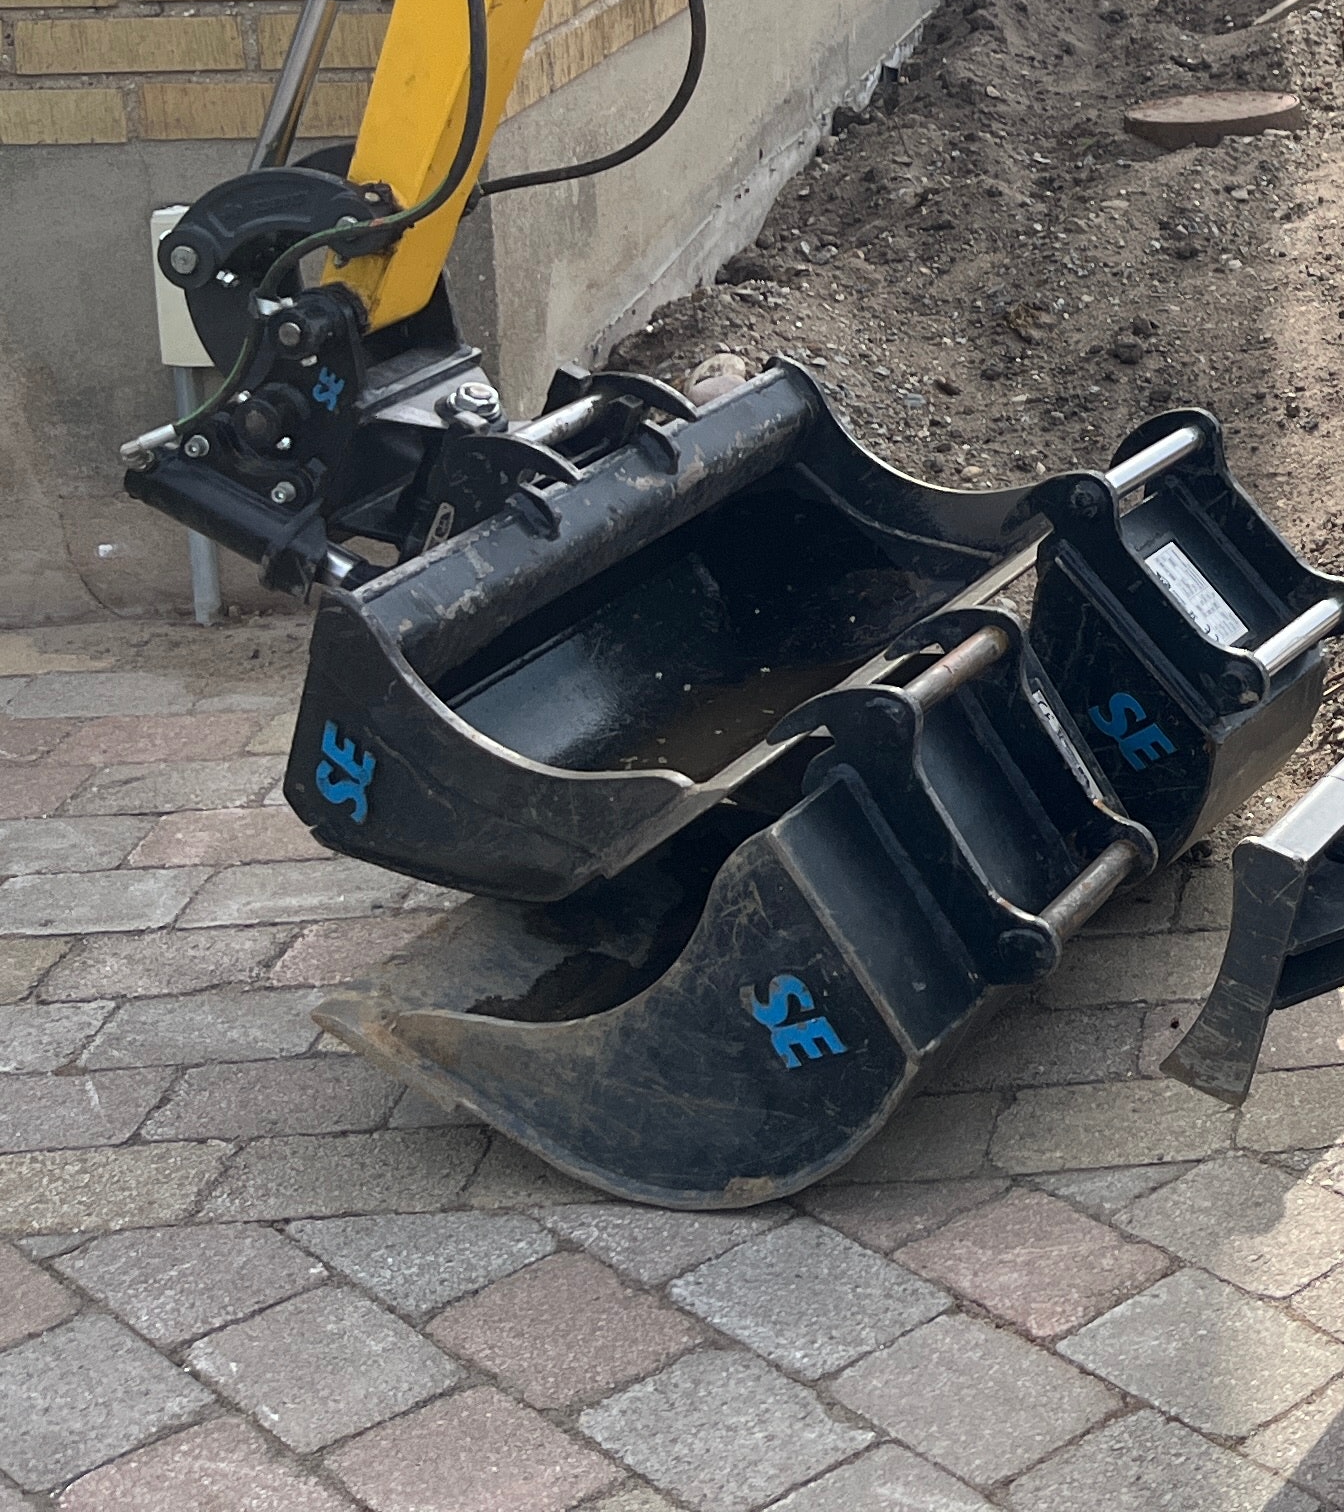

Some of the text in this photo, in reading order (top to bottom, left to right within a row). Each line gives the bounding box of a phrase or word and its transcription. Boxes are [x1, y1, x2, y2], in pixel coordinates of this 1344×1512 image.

[312, 366, 345, 411] SE
[316, 719, 377, 824] SE
[1088, 692, 1177, 771] SE
[739, 974, 848, 1070] SE
